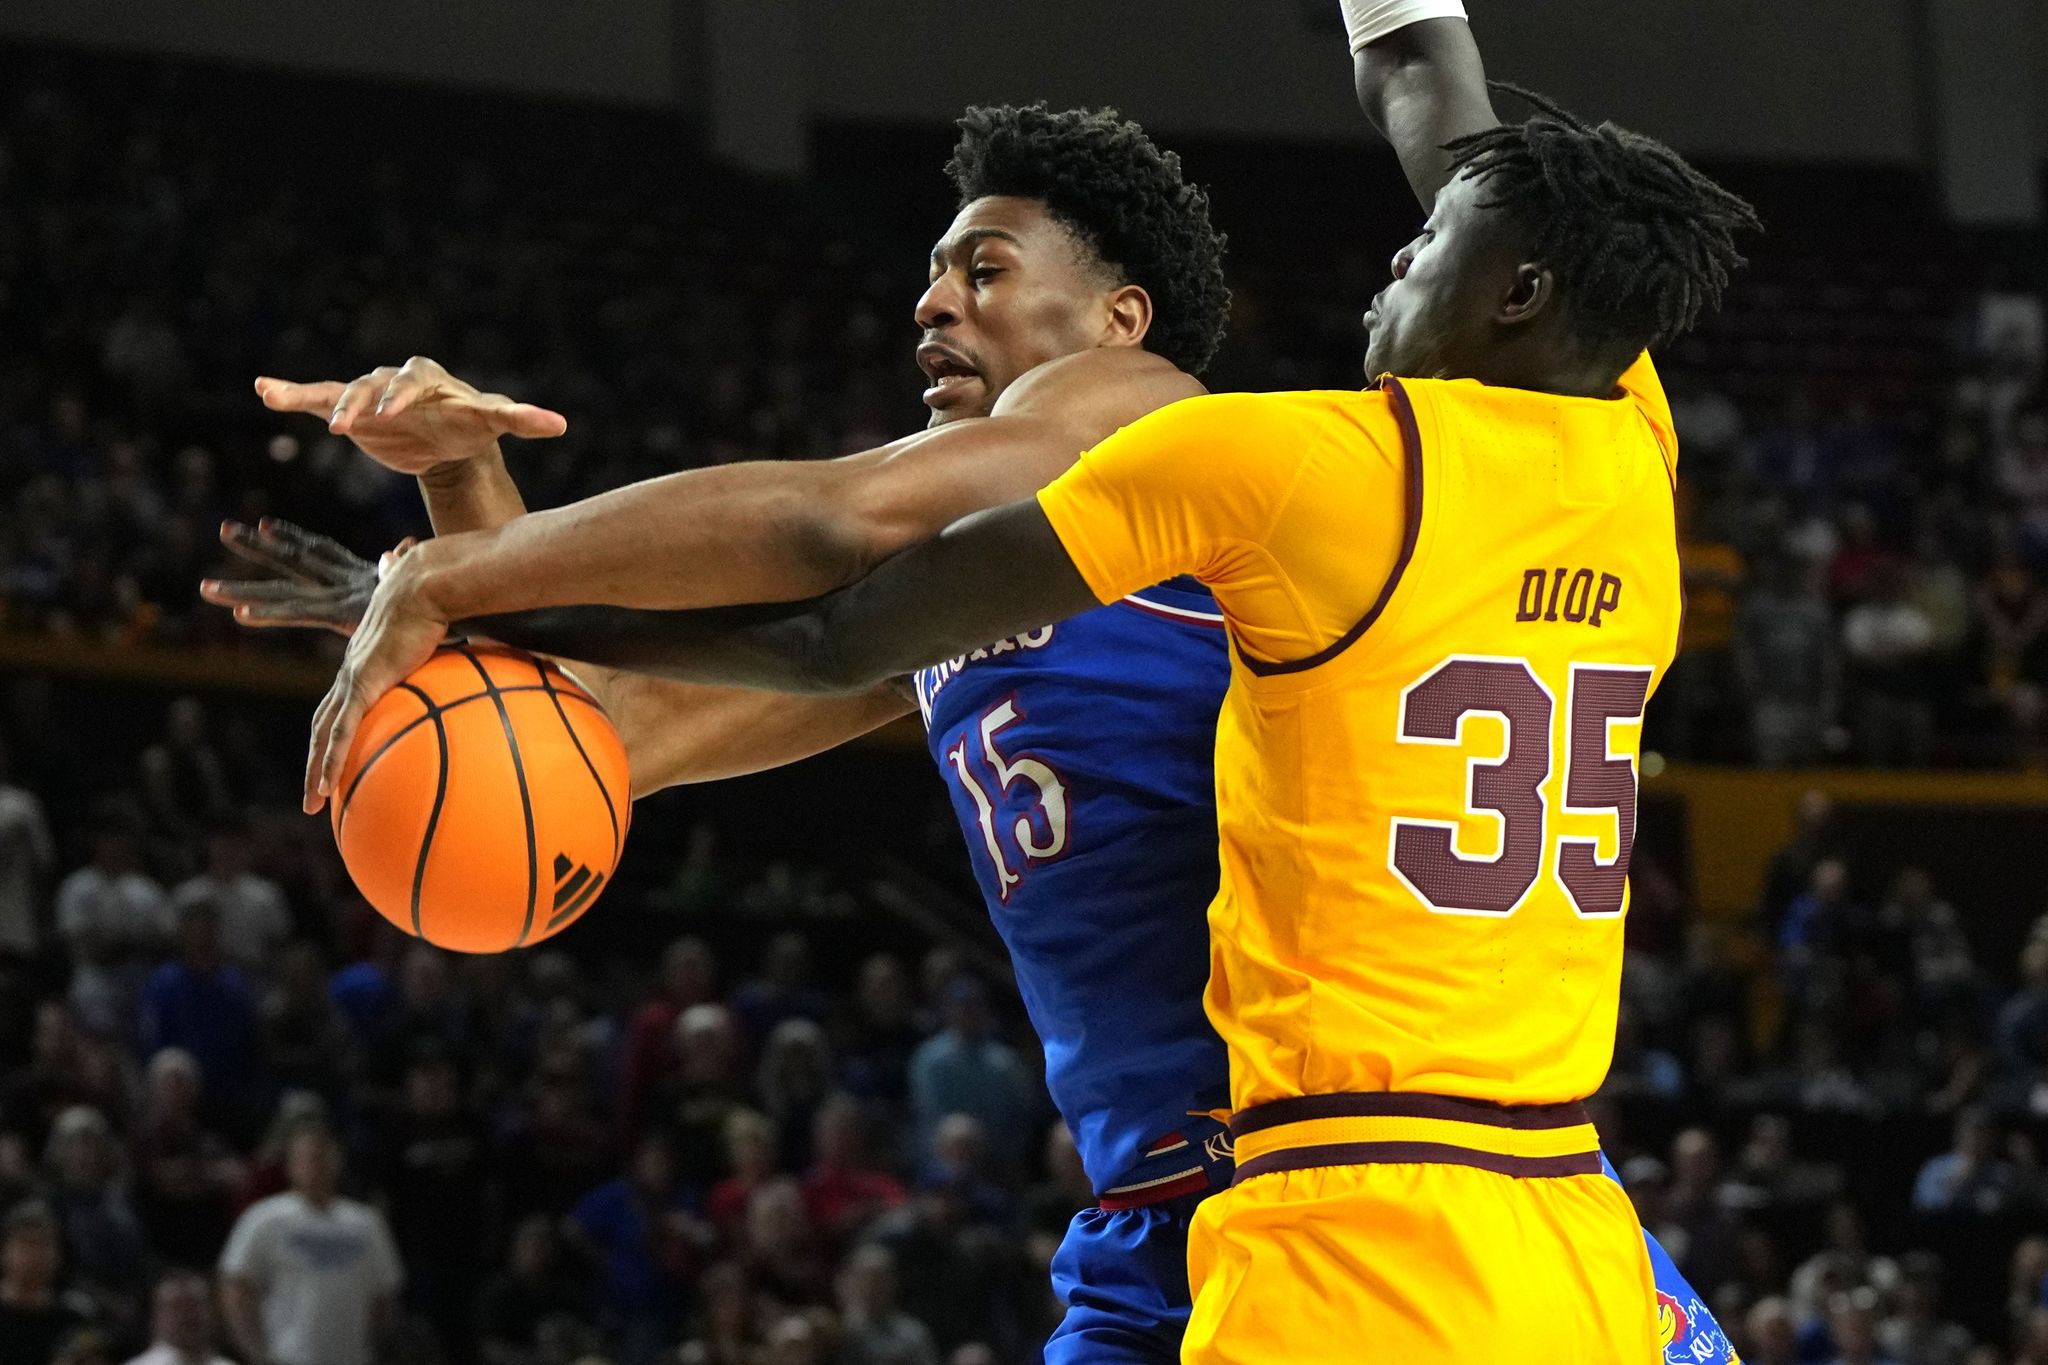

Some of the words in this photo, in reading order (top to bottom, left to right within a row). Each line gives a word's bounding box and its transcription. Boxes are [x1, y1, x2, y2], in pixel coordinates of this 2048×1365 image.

[1515, 567, 1622, 628] DIOP
[947, 692, 1069, 904] 15
[1387, 653, 1656, 919] 35
[1689, 1330, 1715, 1364] KU
